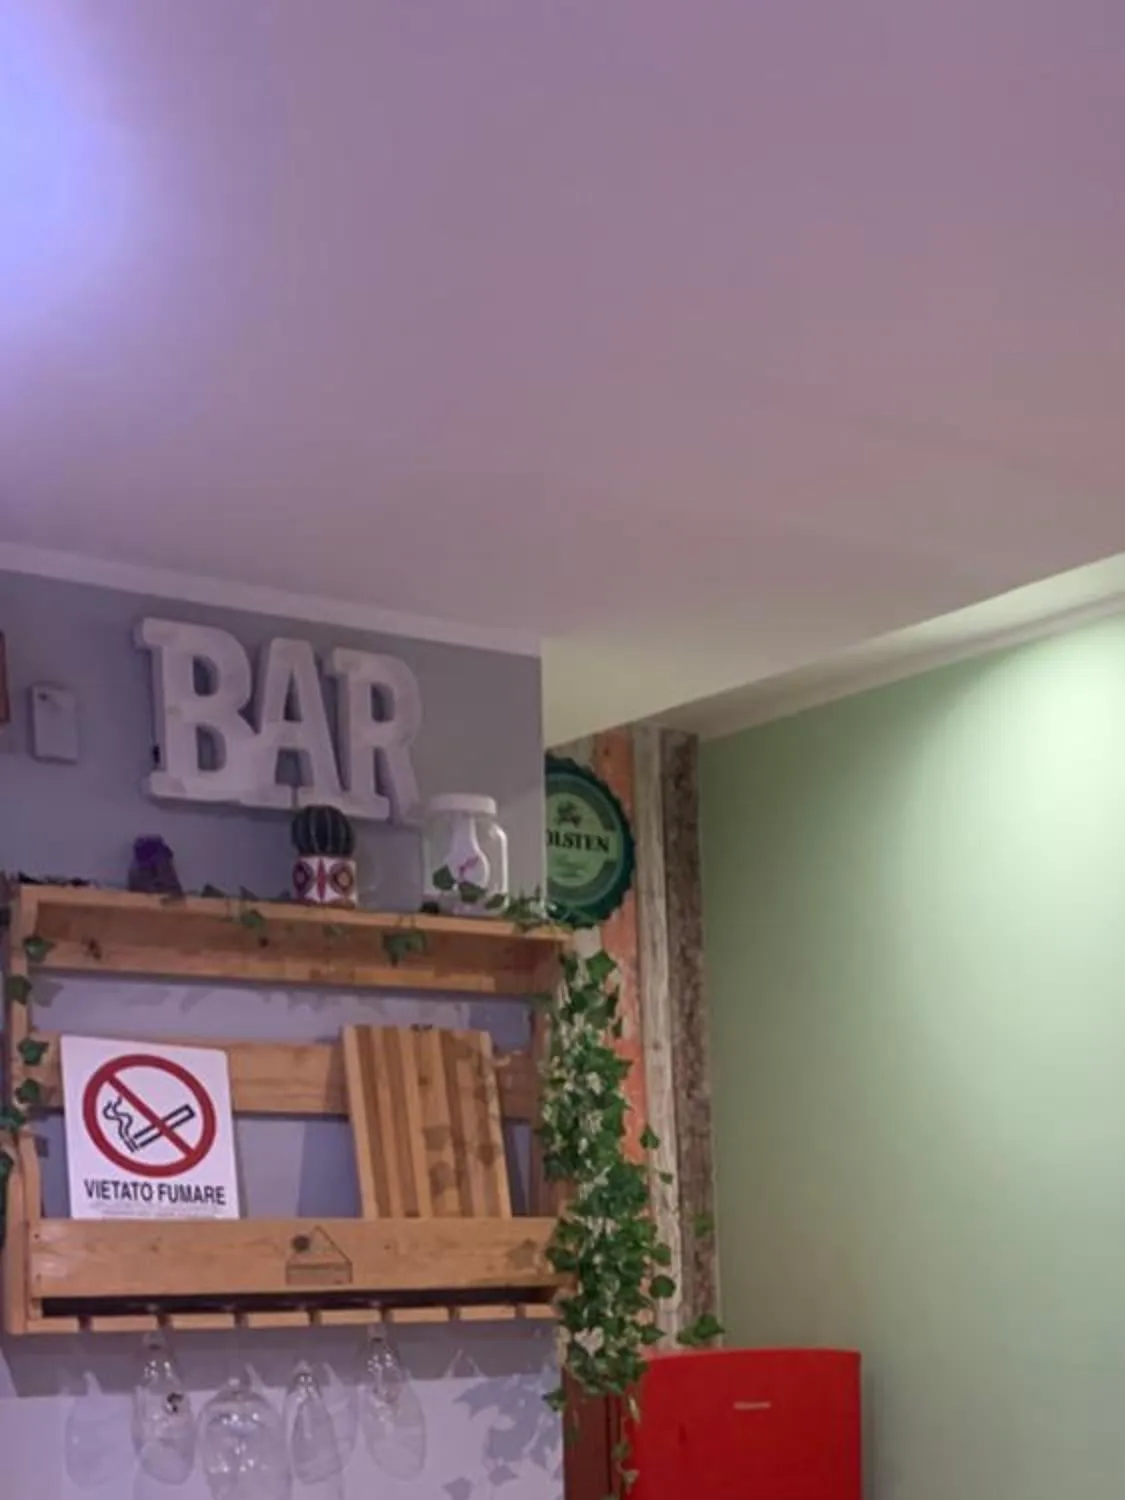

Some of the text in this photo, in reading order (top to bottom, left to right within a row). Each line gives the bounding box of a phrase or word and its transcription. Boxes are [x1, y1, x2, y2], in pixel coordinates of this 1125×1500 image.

[138, 617, 421, 824] BAR
[546, 828, 610, 854] OLSTEN
[83, 1178, 227, 1206] VIETATO FUMARE
